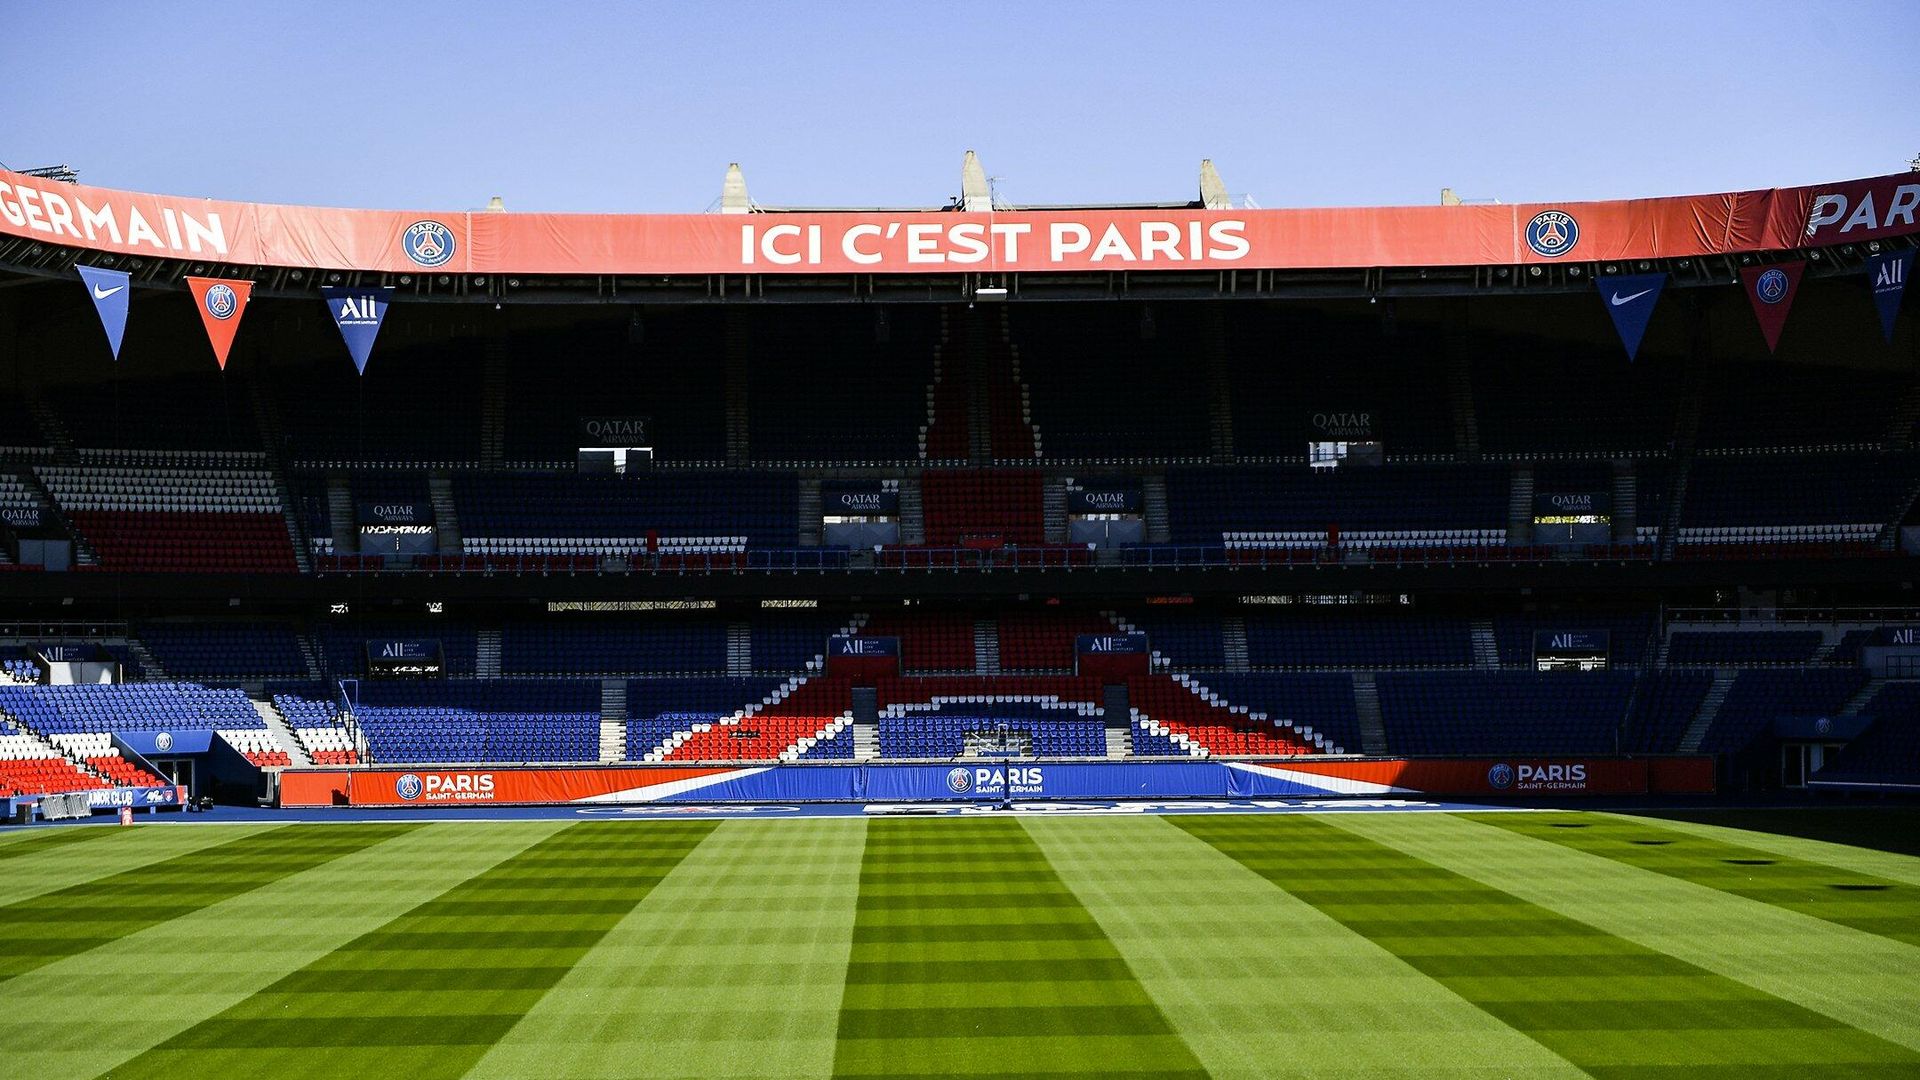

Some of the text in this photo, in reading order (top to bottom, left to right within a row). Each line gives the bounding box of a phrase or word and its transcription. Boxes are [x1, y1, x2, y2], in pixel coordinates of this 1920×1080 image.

[1806, 184, 1920, 236] PAR
[0, 180, 228, 254] GERMAIN
[1535, 213, 1569, 225] PARIS
[411, 223, 445, 235] PARIS
[742, 220, 1250, 265] ICI C'EST PARIS
[1312, 412, 1370, 430] QATAR
[586, 420, 644, 437] QATAR
[601, 435, 646, 443] AIRWAYS
[841, 494, 880, 505] QATAR
[1086, 492, 1124, 504] QATAR
[1551, 495, 1591, 507] QATAR
[2, 509, 39, 520] QATAR
[373, 505, 414, 516] QATAR
[976, 768, 1043, 785] PARIS
[1518, 764, 1586, 781] PARIS
[426, 774, 495, 792] PARIS
[976, 785, 1042, 793] SAINT-ERMAIN
[111, 790, 133, 806] CLUB
[426, 792, 494, 800] SAINT-GERMAIN
